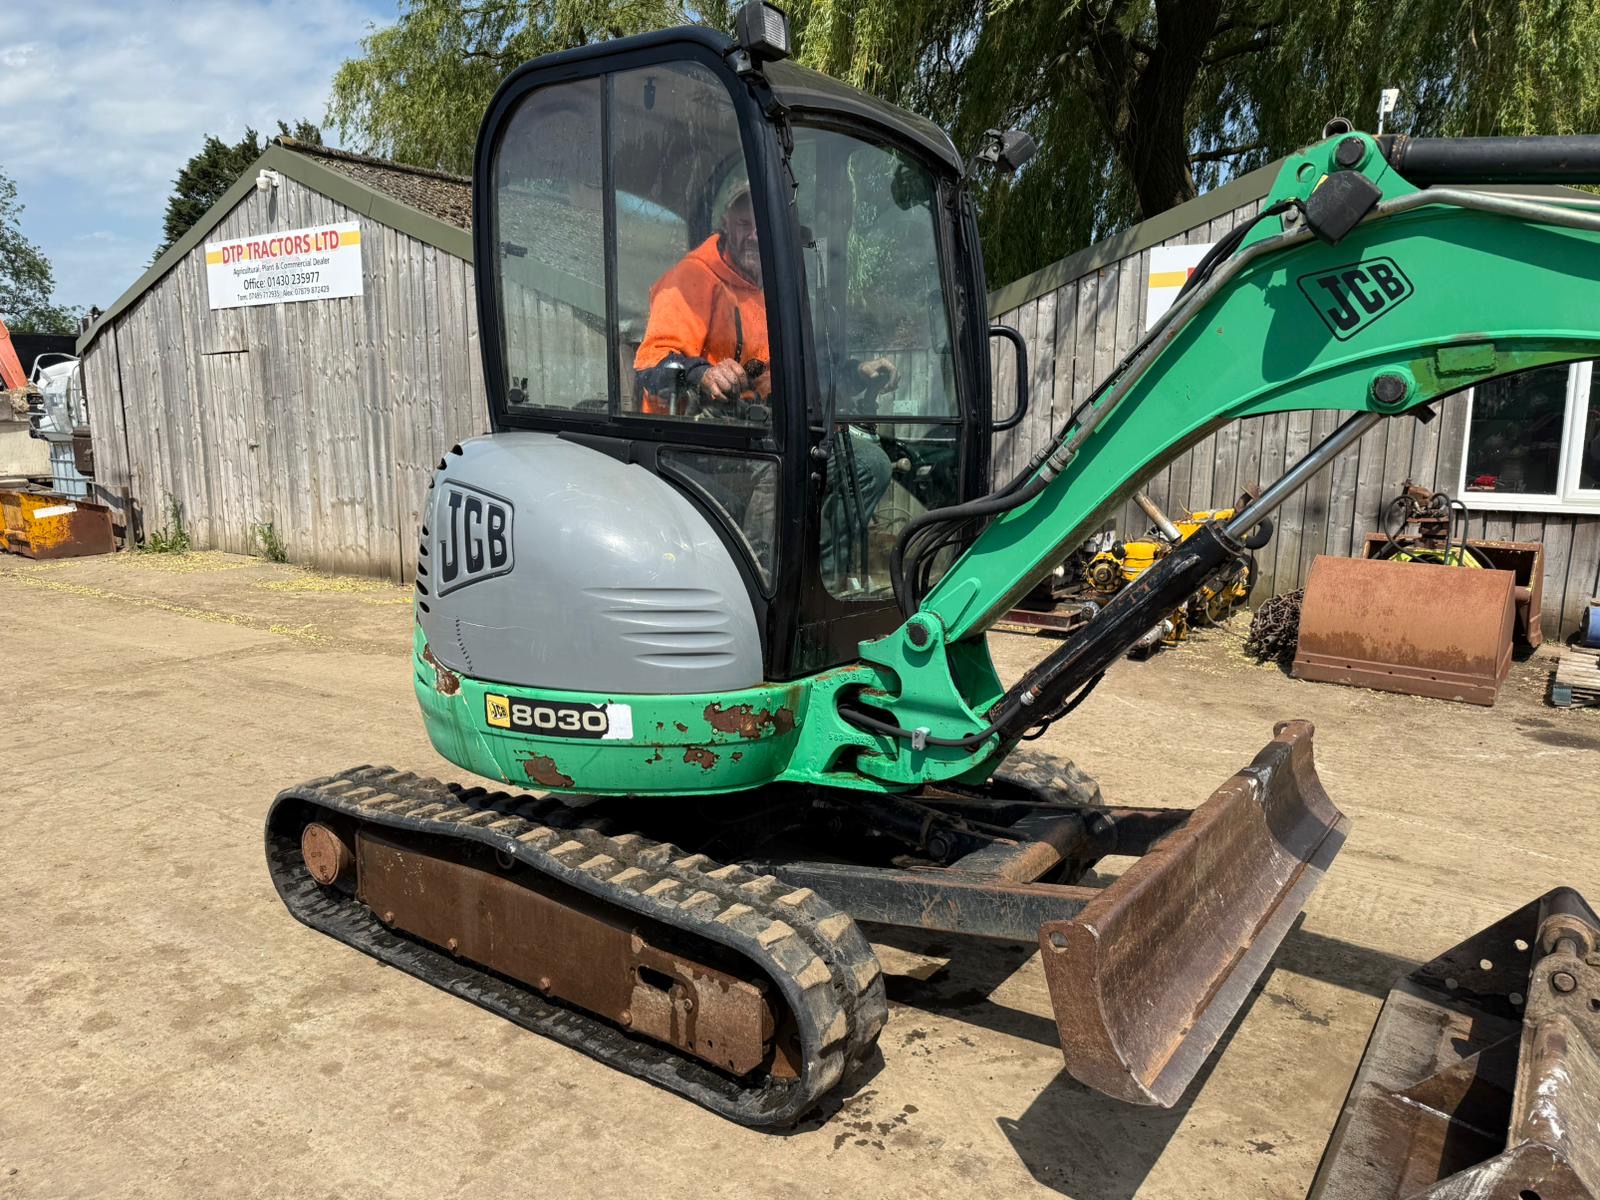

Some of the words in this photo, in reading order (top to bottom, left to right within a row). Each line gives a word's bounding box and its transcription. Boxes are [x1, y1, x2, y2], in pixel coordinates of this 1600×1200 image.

[222, 244, 243, 264] DTP
[247, 234, 310, 260] TRACTORS
[315, 230, 339, 251] LTD
[262, 263, 274, 272] Plant
[281, 258, 311, 270] Commercial
[313, 256, 330, 266] Dealer
[244, 278, 265, 290] Office:
[267, 274, 289, 287] 01430
[291, 271, 319, 285] 235977
[1316, 263, 1405, 331] JCB
[440, 490, 507, 583] JCB
[490, 702, 508, 719] JCB
[512, 704, 607, 731] 8030
